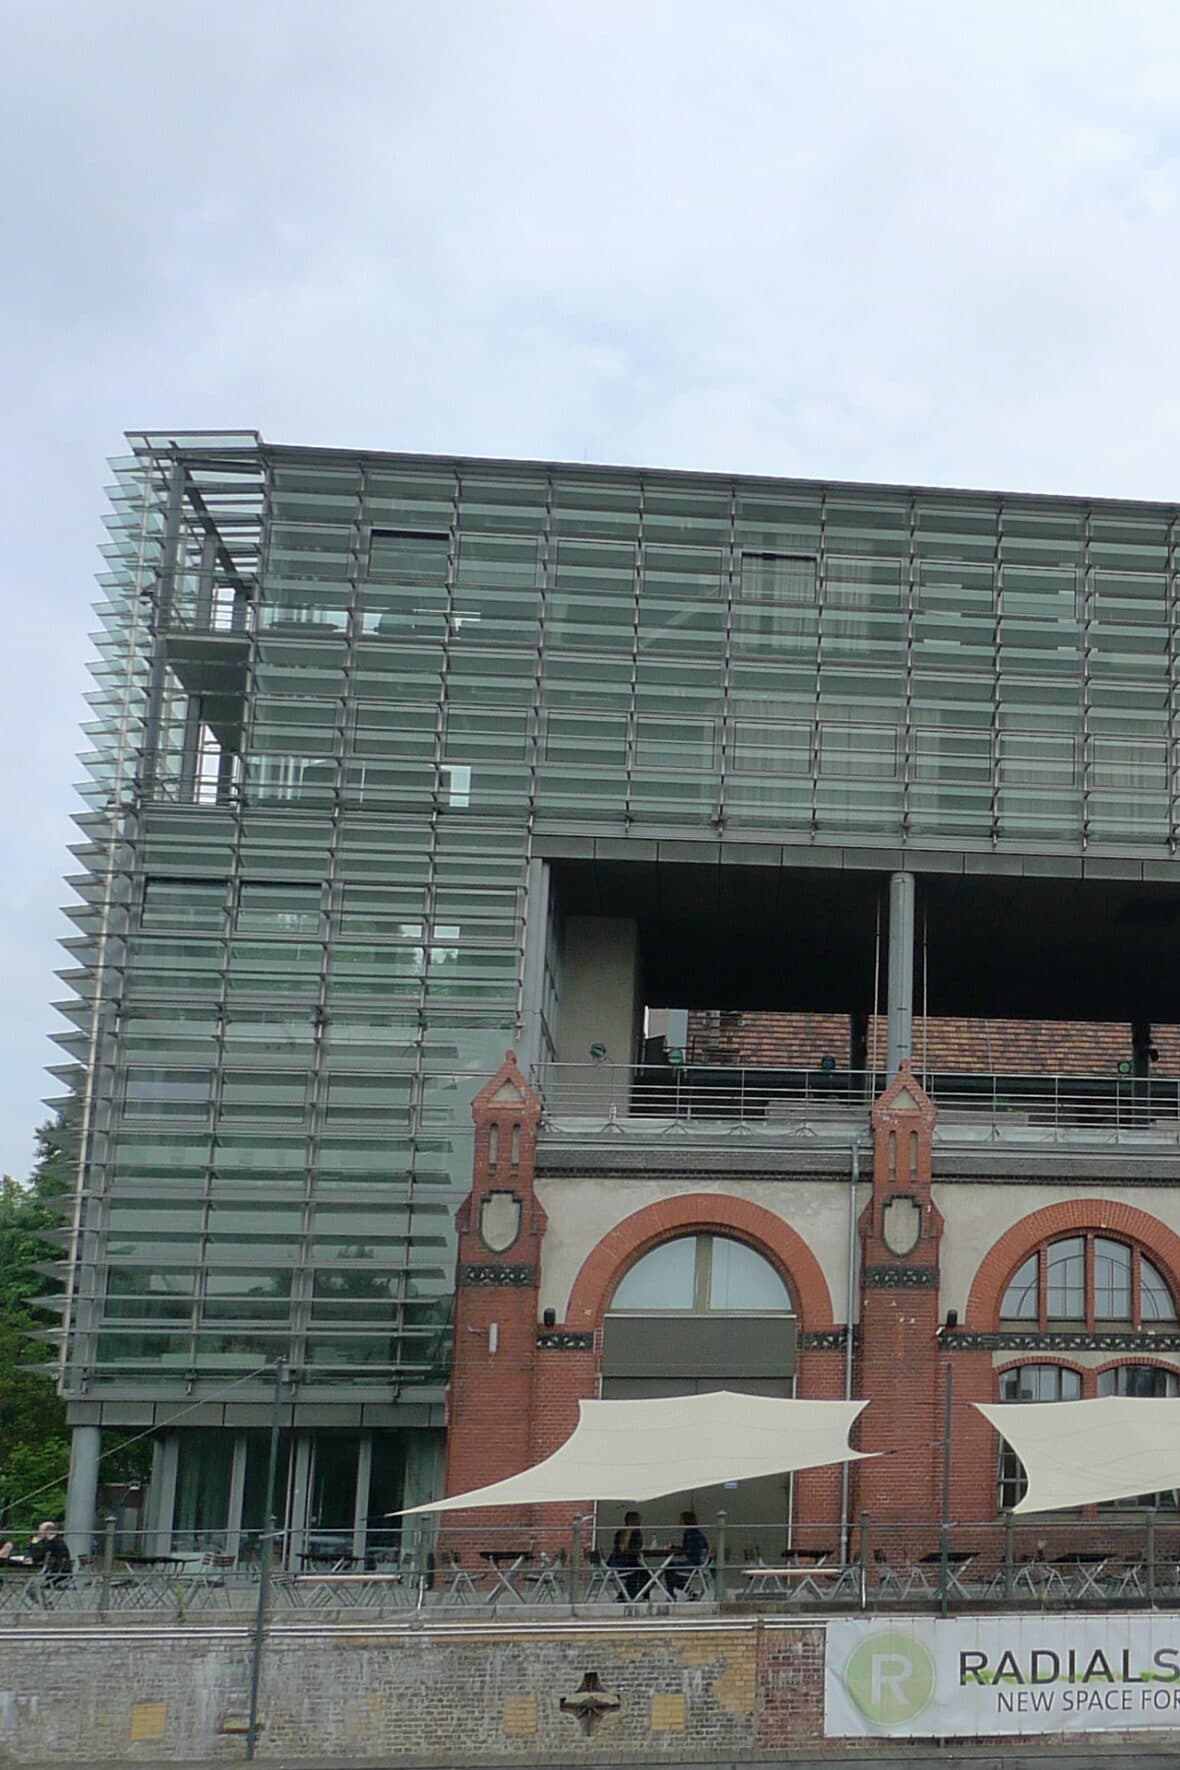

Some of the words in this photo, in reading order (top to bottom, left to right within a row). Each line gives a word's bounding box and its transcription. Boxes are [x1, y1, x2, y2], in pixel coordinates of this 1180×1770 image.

[870, 1652, 913, 1706] R
[997, 1691, 1055, 1712] NEW
[1062, 1689, 1133, 1711] SPACE
